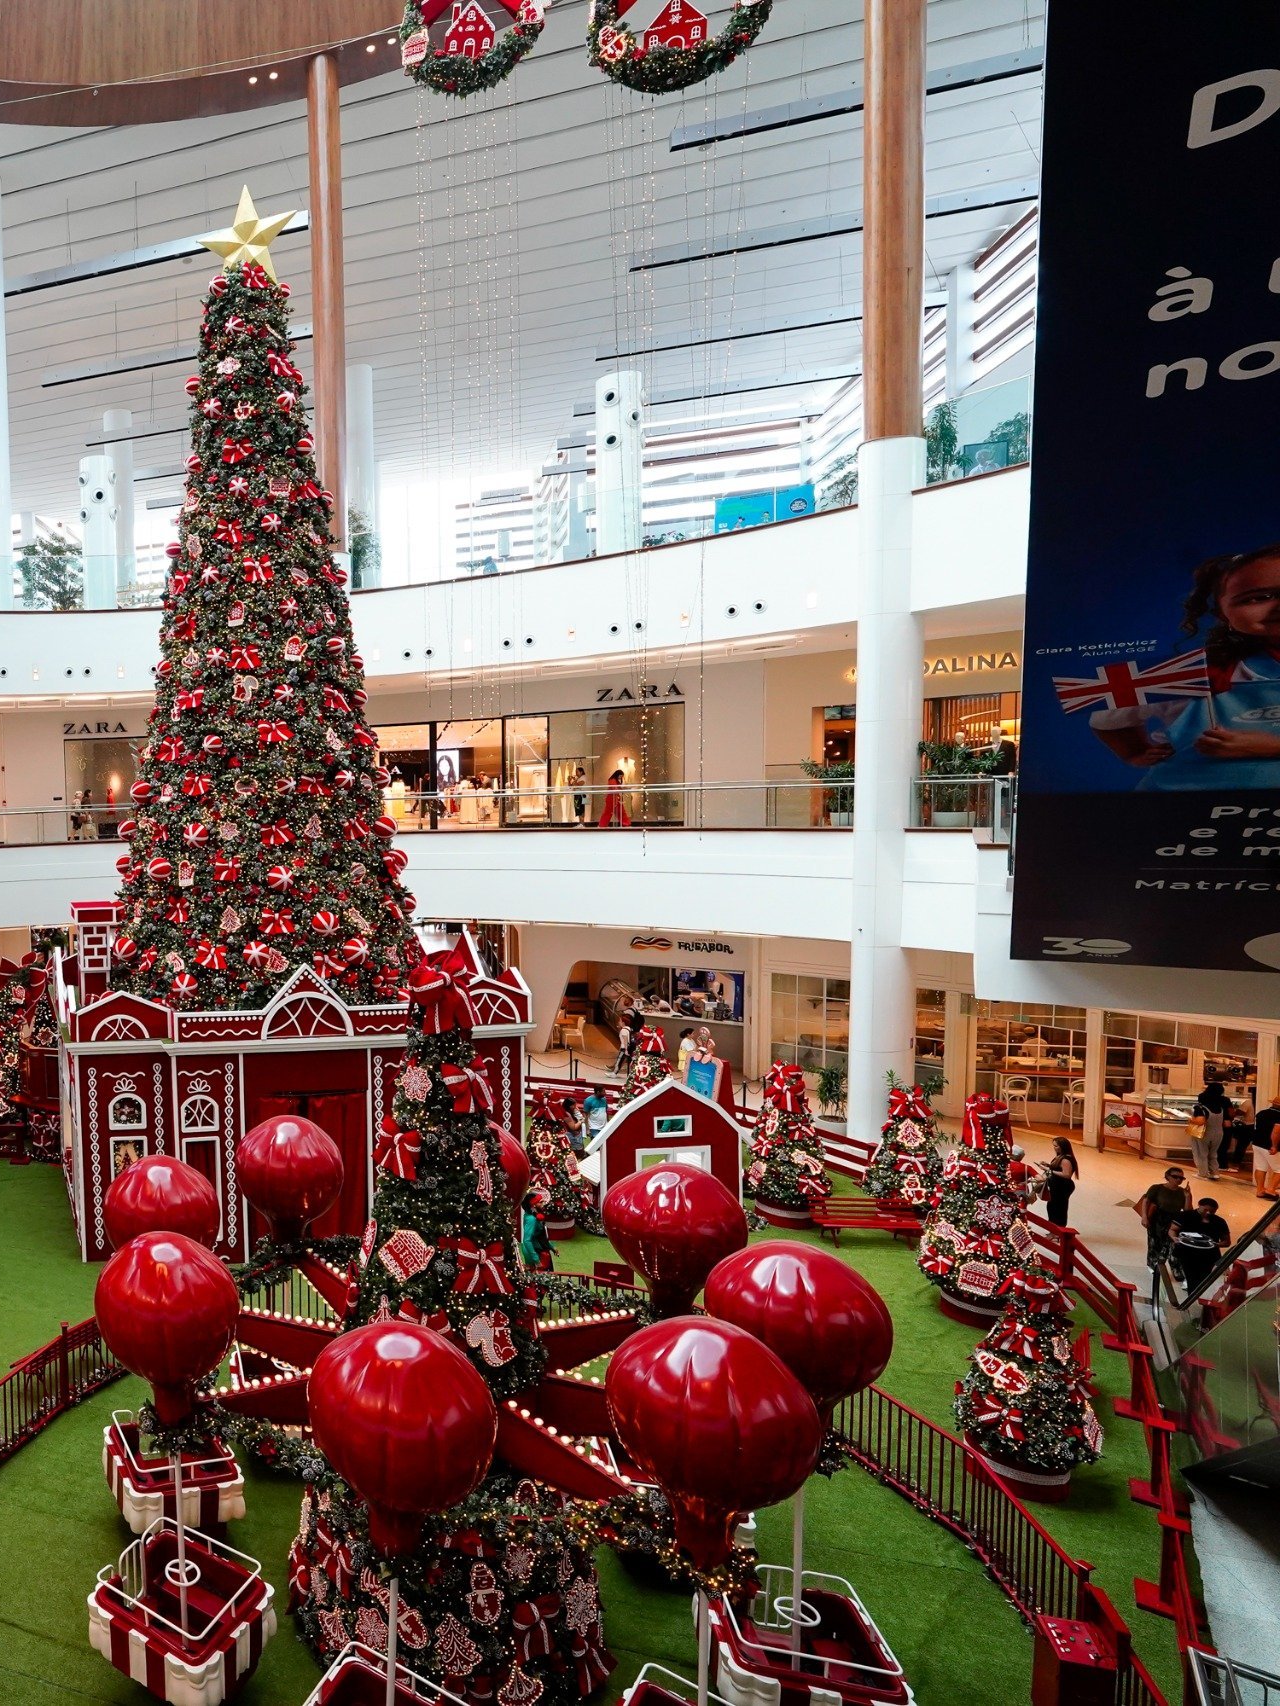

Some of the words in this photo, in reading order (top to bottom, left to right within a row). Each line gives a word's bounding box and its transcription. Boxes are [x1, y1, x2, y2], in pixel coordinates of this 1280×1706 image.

[1147, 266, 1214, 322] à
[1036, 646, 1072, 655] Clara
[1082, 649, 1120, 657] Aluna
[1125, 645, 1156, 653] GGE
[596, 683, 685, 702] ZARA
[64, 722, 127, 735] ZARA
[1210, 806, 1280, 819] Pr
[1189, 827, 1218, 838] e
[1155, 843, 1218, 857] de
[1135, 880, 1280, 891] Matríc
